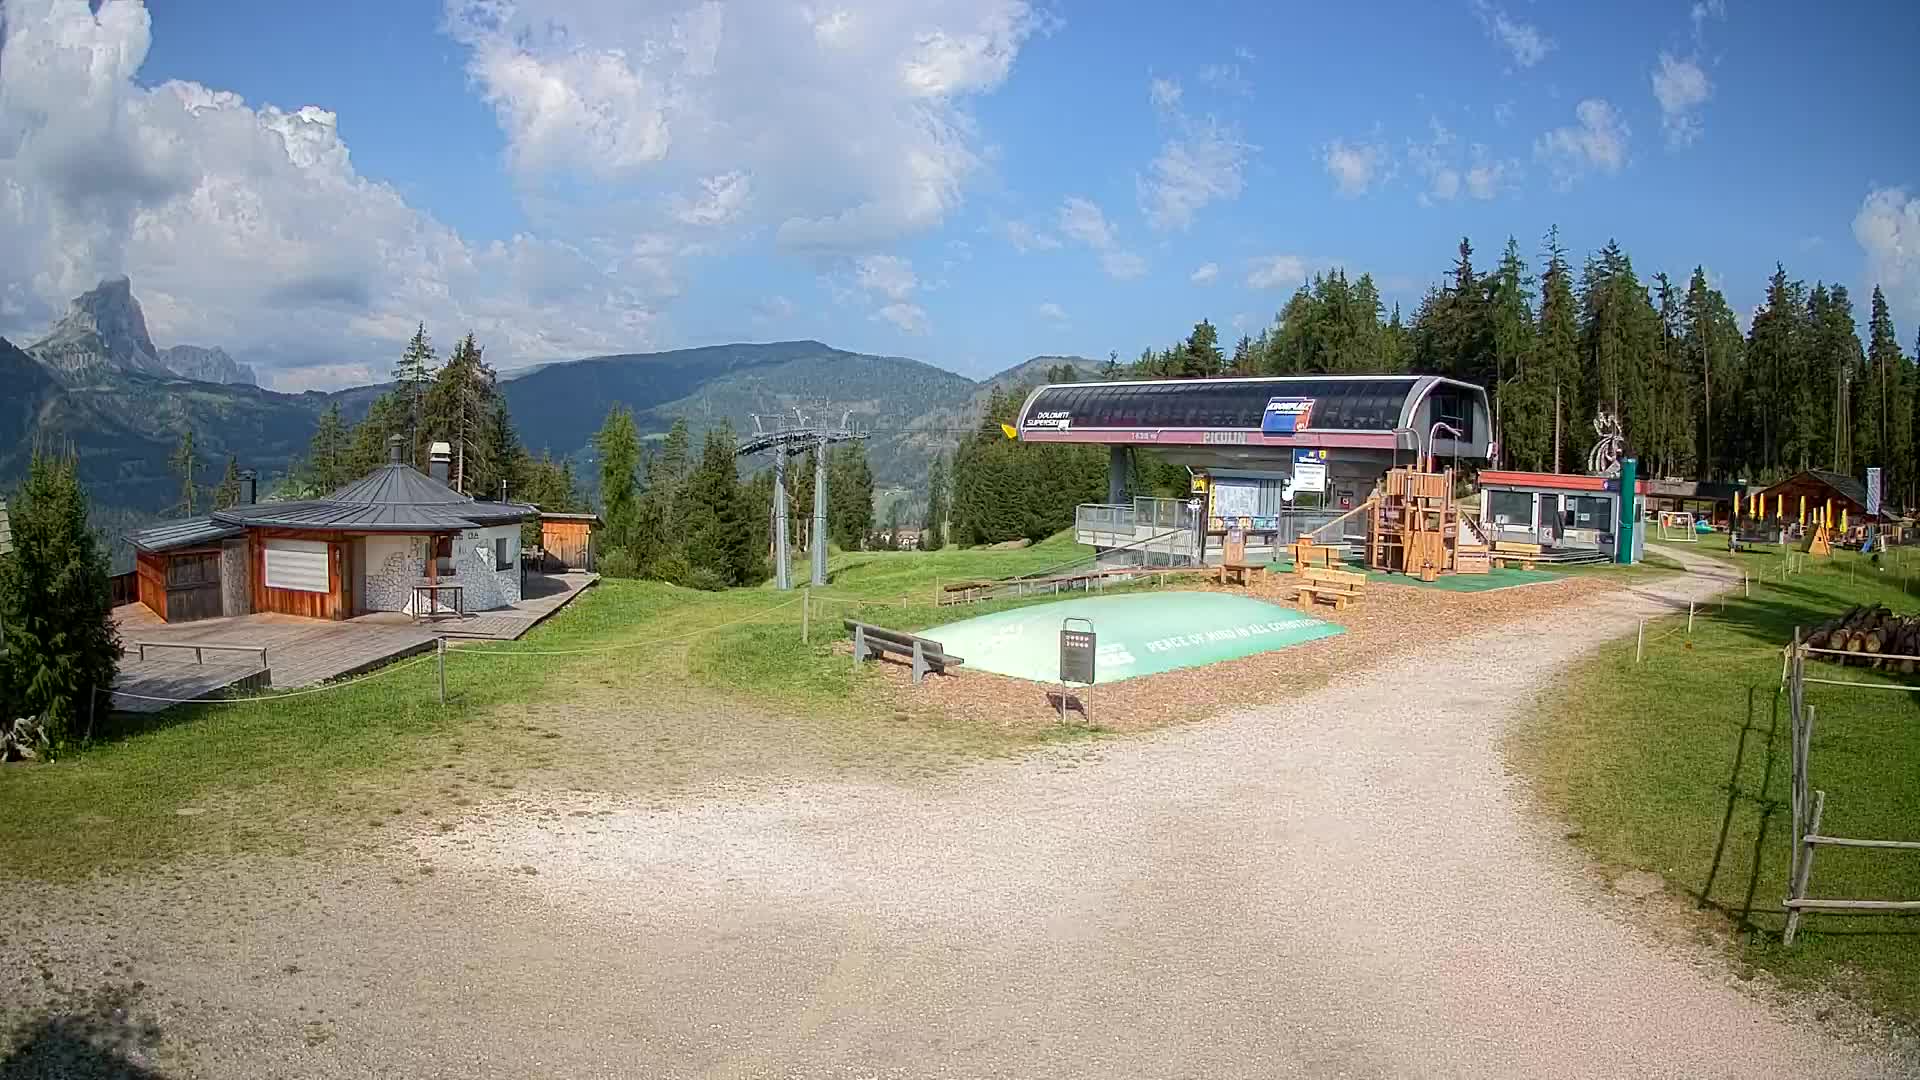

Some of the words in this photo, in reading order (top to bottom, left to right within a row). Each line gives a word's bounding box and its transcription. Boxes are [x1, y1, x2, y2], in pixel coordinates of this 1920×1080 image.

[1037, 411, 1070, 419] DOLOMITI
[1203, 431, 1247, 445] PICULIN
[1146, 635, 1190, 653] PEACE
[1189, 631, 1205, 646] OF
[1205, 628, 1237, 641] MIND
